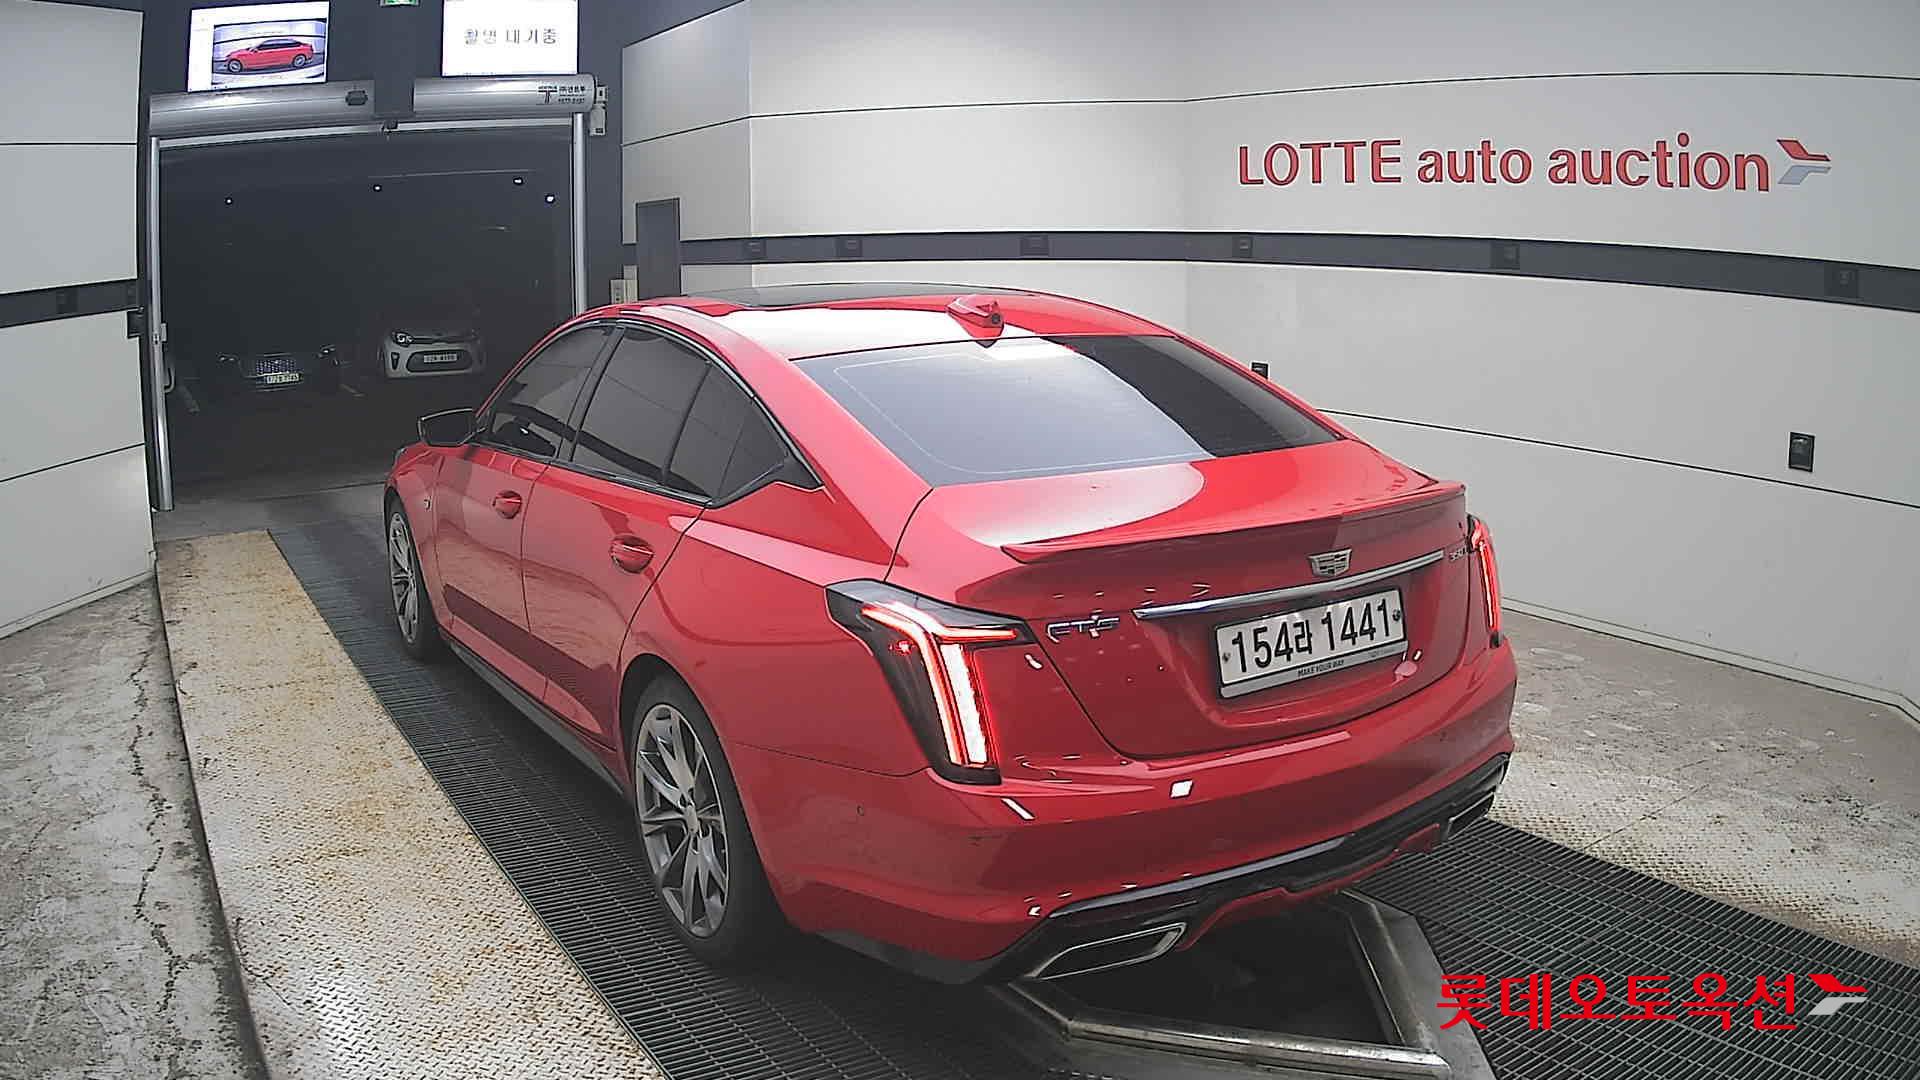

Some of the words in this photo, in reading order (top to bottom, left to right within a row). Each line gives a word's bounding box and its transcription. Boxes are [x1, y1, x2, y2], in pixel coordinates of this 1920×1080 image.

[1239, 139, 1401, 186] LOTTE
[1417, 139, 1532, 185] auto
[1548, 132, 1770, 192] auction
[1232, 619, 1312, 673] 154라
[1321, 598, 1390, 651] 1441
